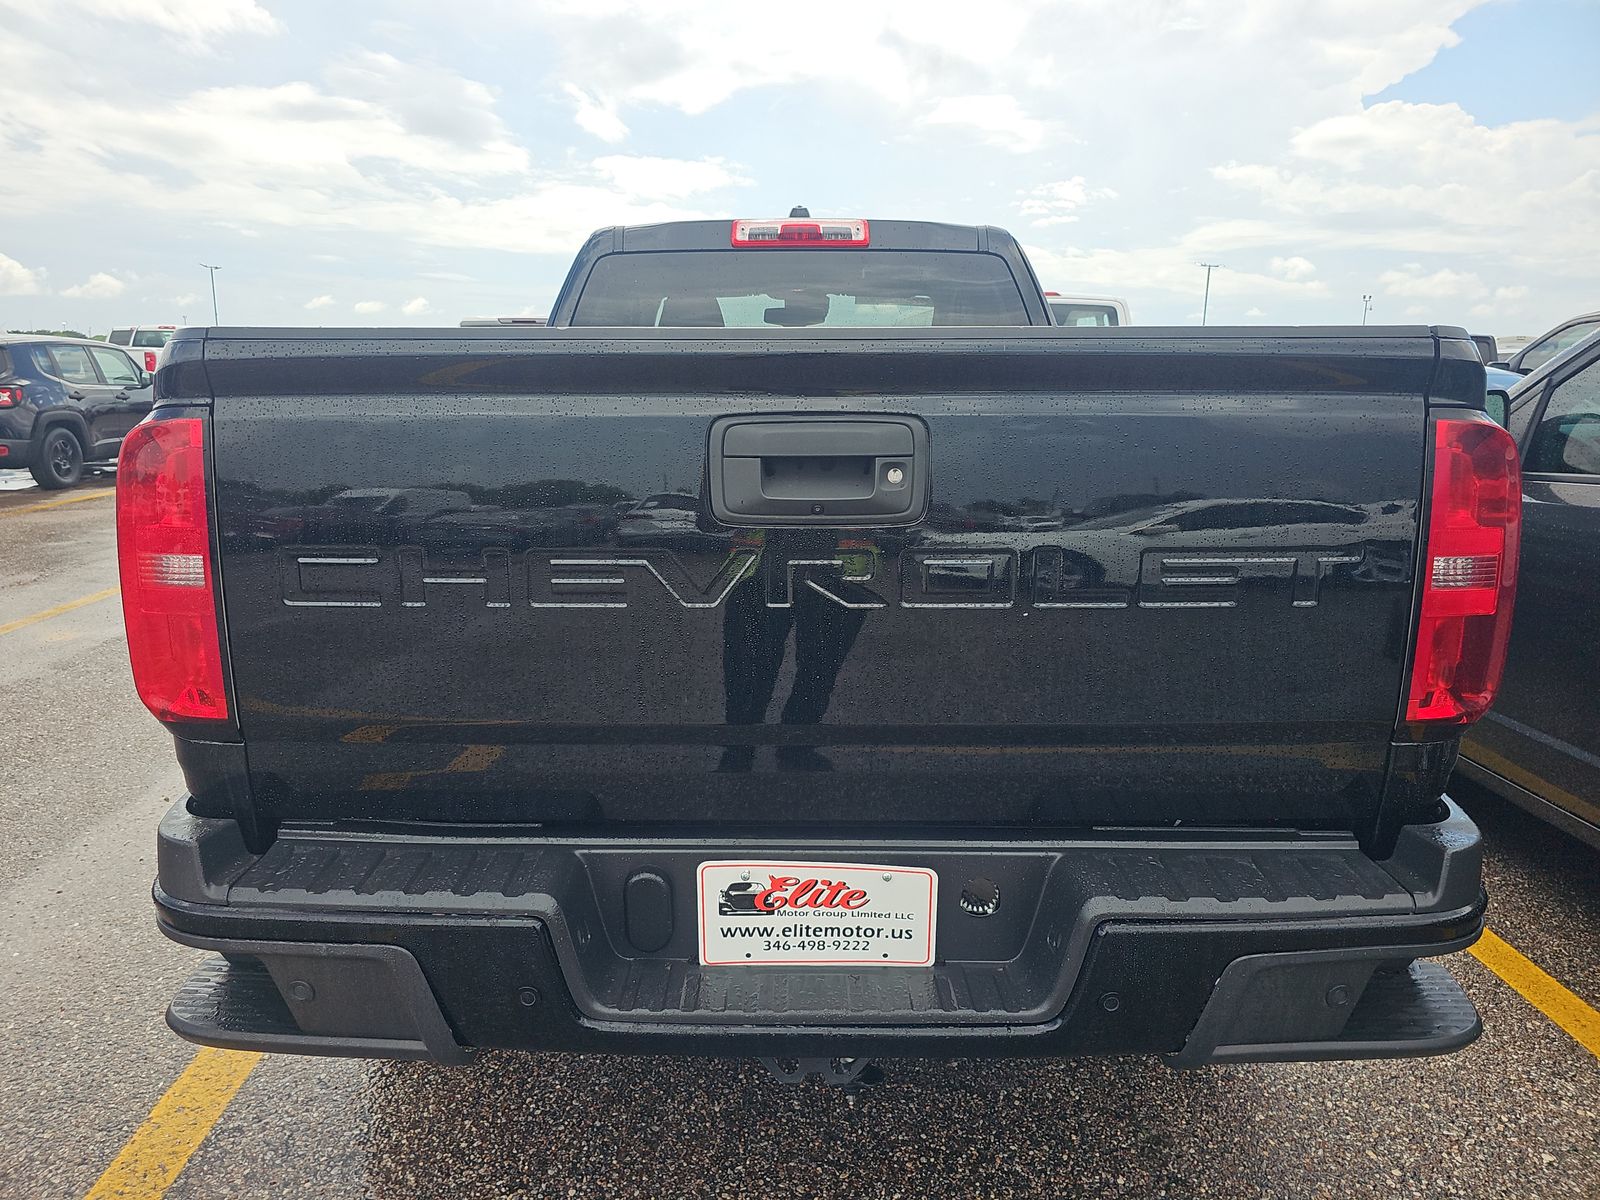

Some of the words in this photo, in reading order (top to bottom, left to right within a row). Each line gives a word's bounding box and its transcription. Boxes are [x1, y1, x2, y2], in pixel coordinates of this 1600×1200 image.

[277, 546, 1364, 609] CHEVROLET
[754, 874, 870, 911] Elite
[776, 909, 810, 917] Motor
[812, 909, 848, 919] Group
[851, 911, 891, 919] Limited
[894, 912, 915, 920] LLC
[720, 924, 913, 940] www.elitemotor.us
[763, 940, 870, 951] 346-498-9222
